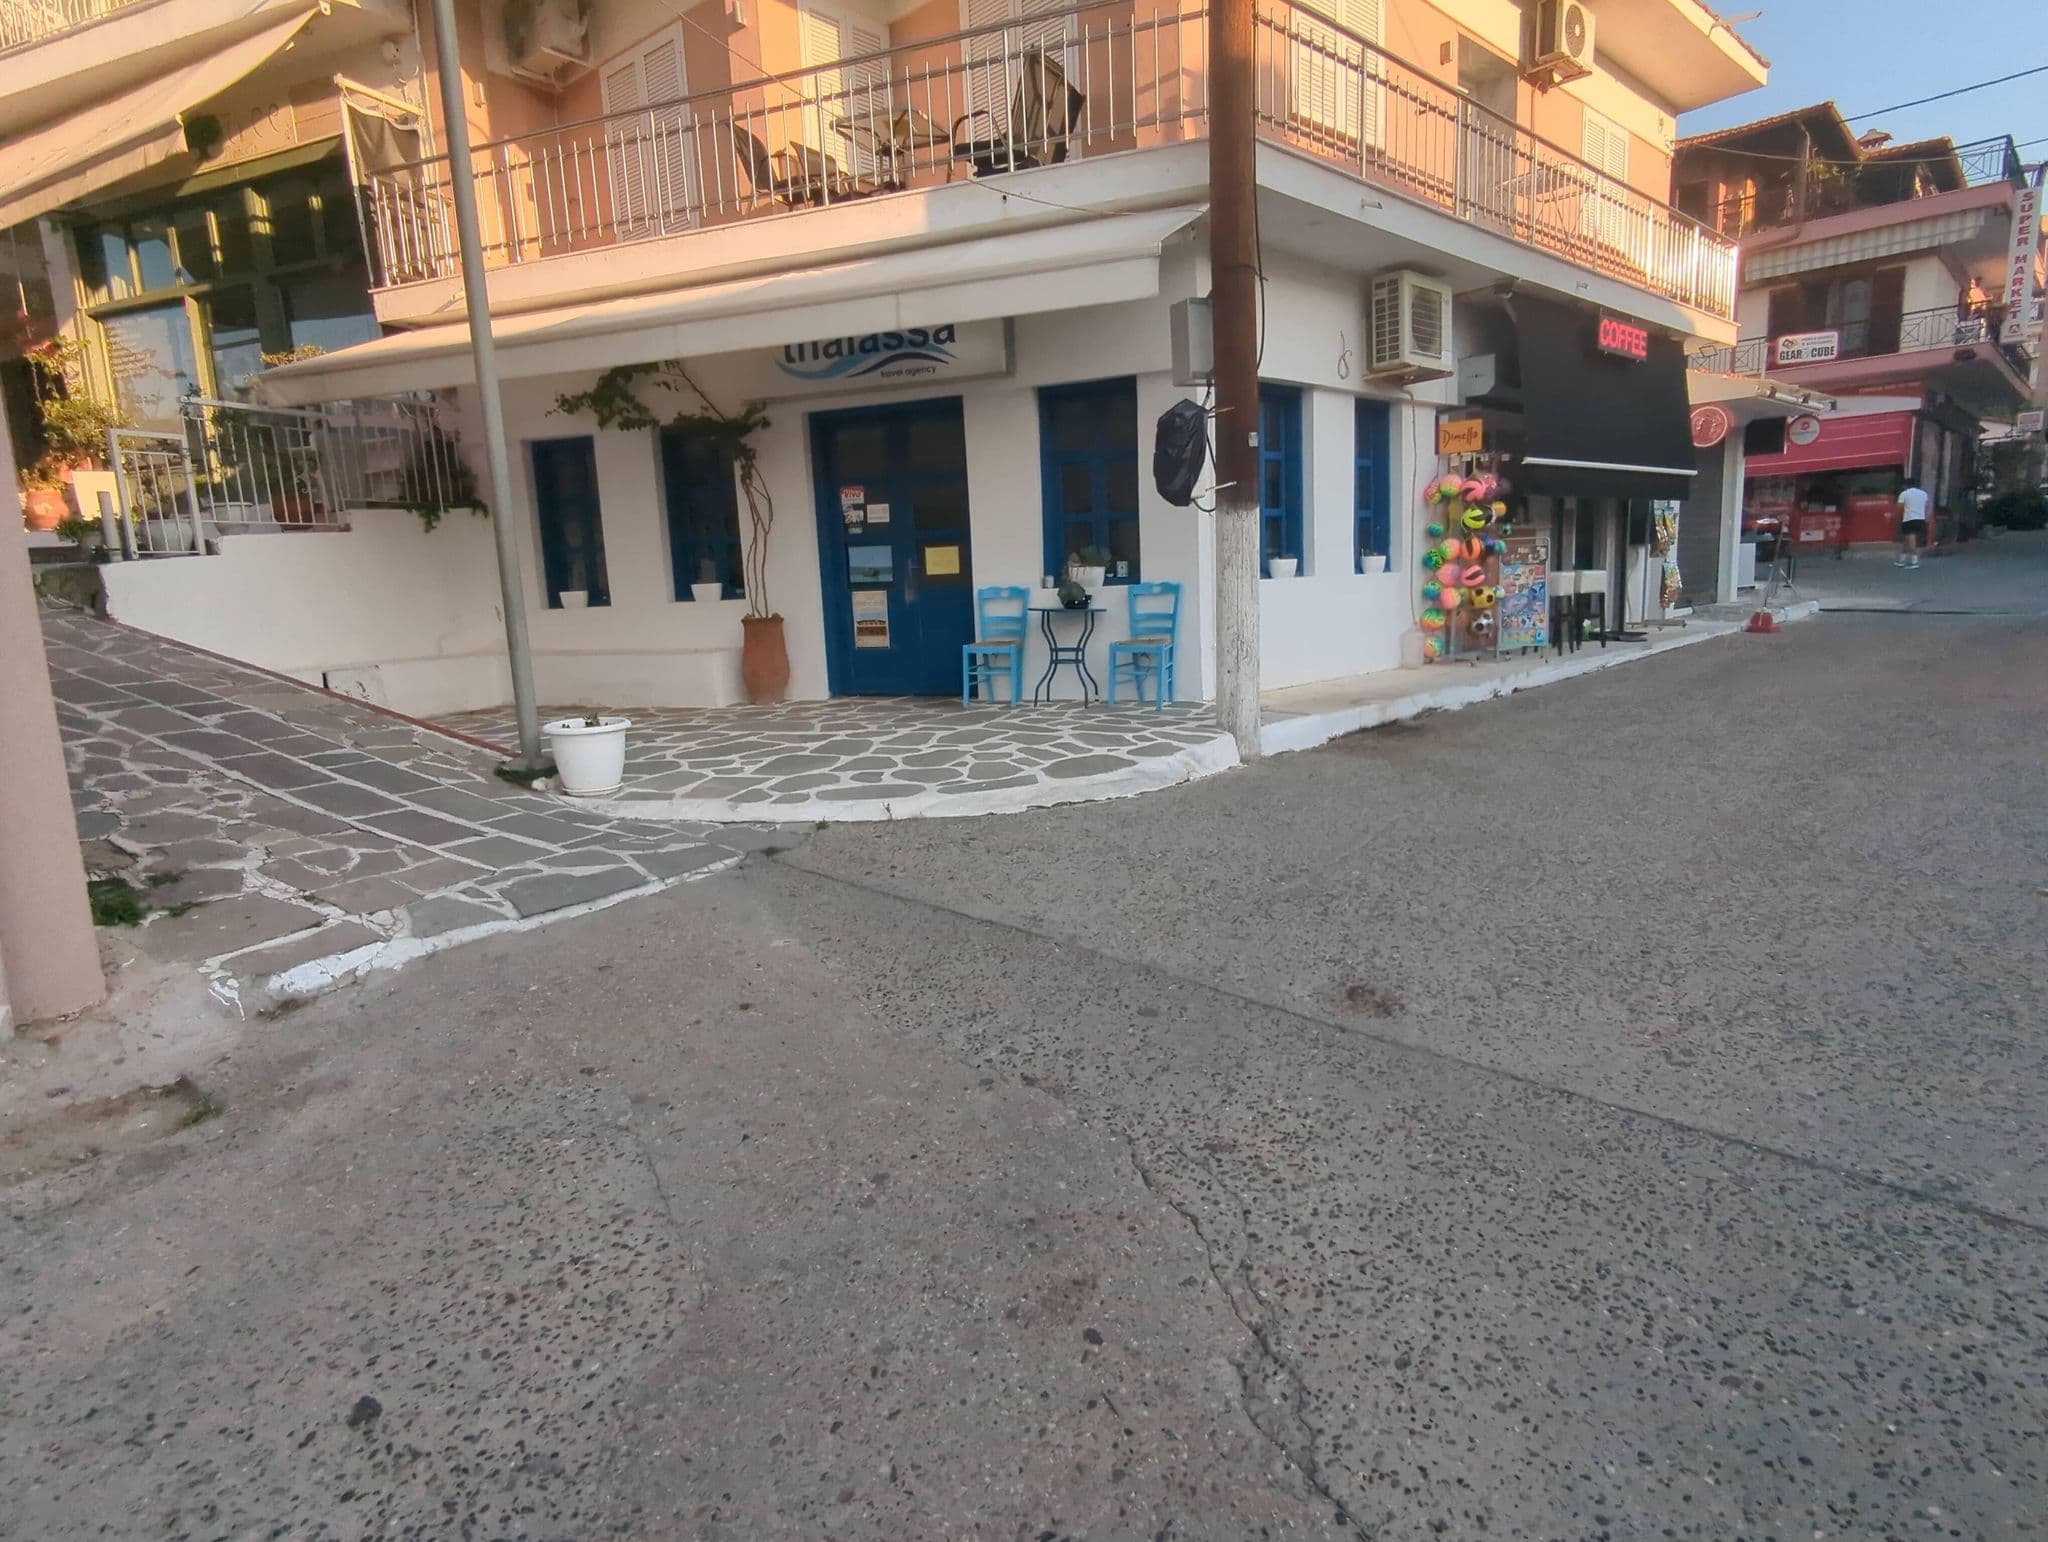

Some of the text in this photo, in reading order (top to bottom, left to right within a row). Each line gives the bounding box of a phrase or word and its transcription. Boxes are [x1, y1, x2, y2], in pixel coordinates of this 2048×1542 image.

[2016, 190, 2034, 247] SUPER
[2009, 254, 2028, 320] MARKET
[1600, 318, 1648, 357] COFFEE
[1780, 345, 1835, 361] GEAR CUBE
[880, 366, 936, 378] travel agency
